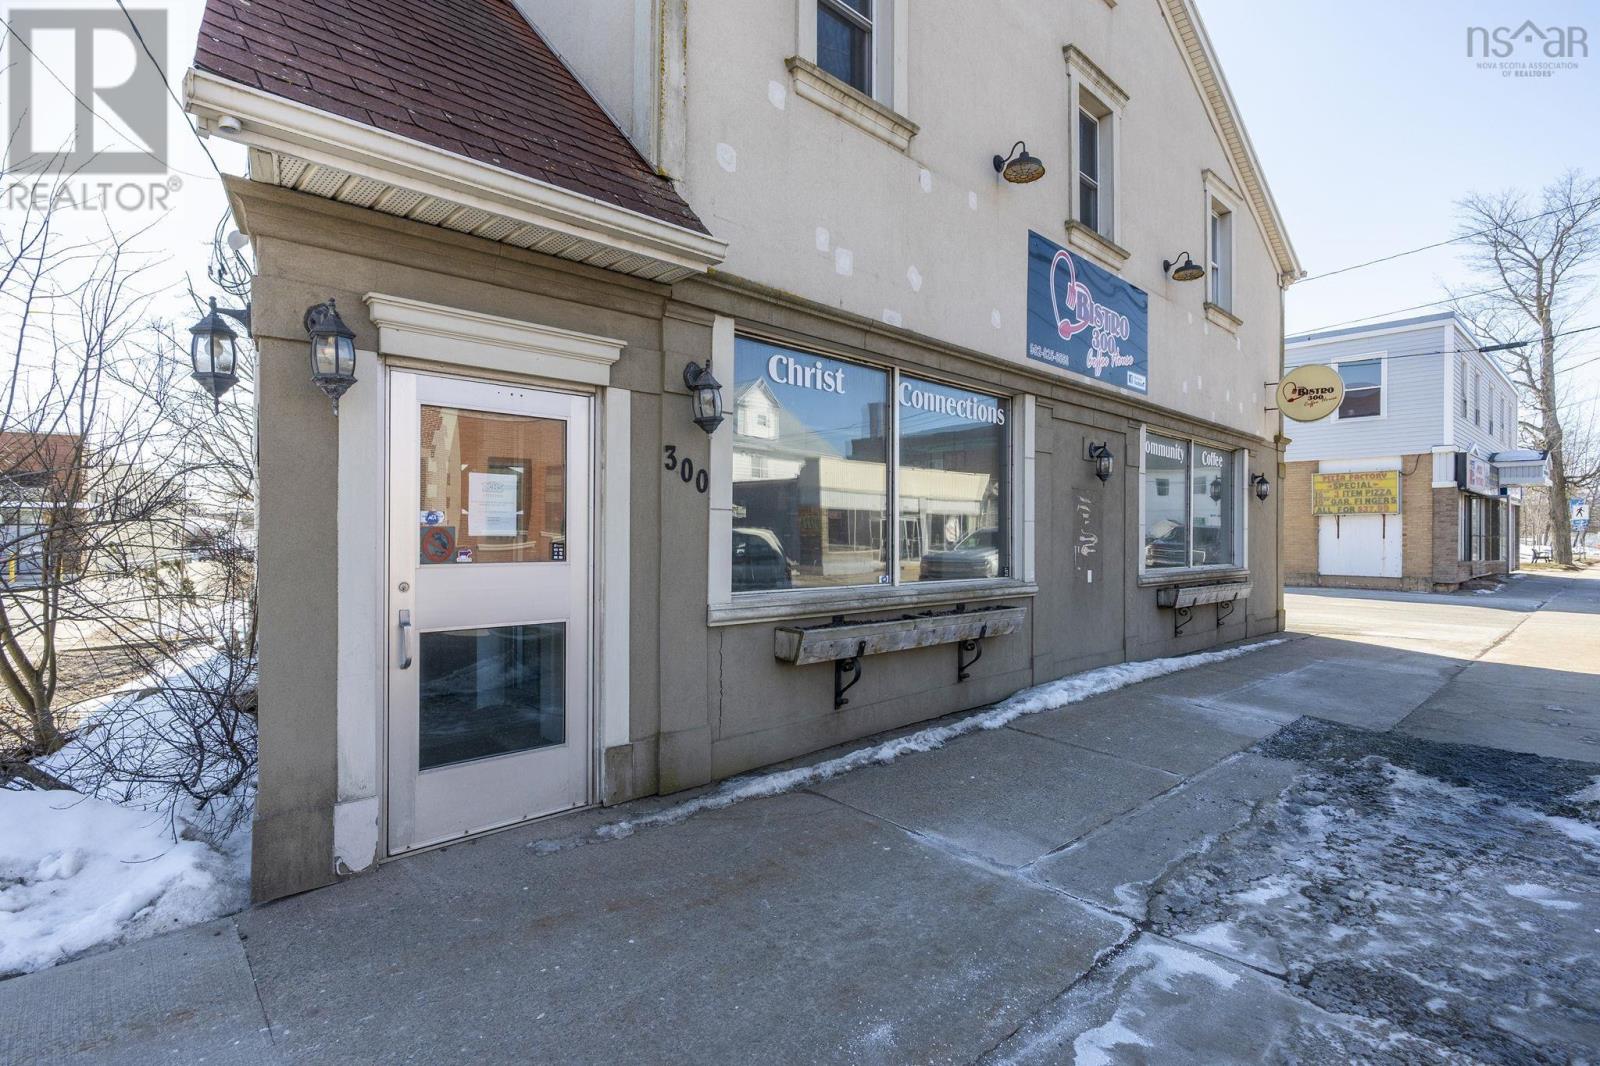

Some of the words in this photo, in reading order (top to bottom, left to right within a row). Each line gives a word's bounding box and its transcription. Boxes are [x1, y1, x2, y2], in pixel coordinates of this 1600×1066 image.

[1092, 328, 1116, 355] 300
[768, 354, 846, 394] Christ
[1086, 348, 1109, 376] Coffee
[898, 382, 1005, 425] Connections
[1145, 440, 1185, 464] ommunity
[1202, 450, 1223, 467] Coffee
[664, 445, 709, 493] 300
[1342, 489, 1363, 497] ITEM
[1365, 488, 1392, 496] PIZZA
